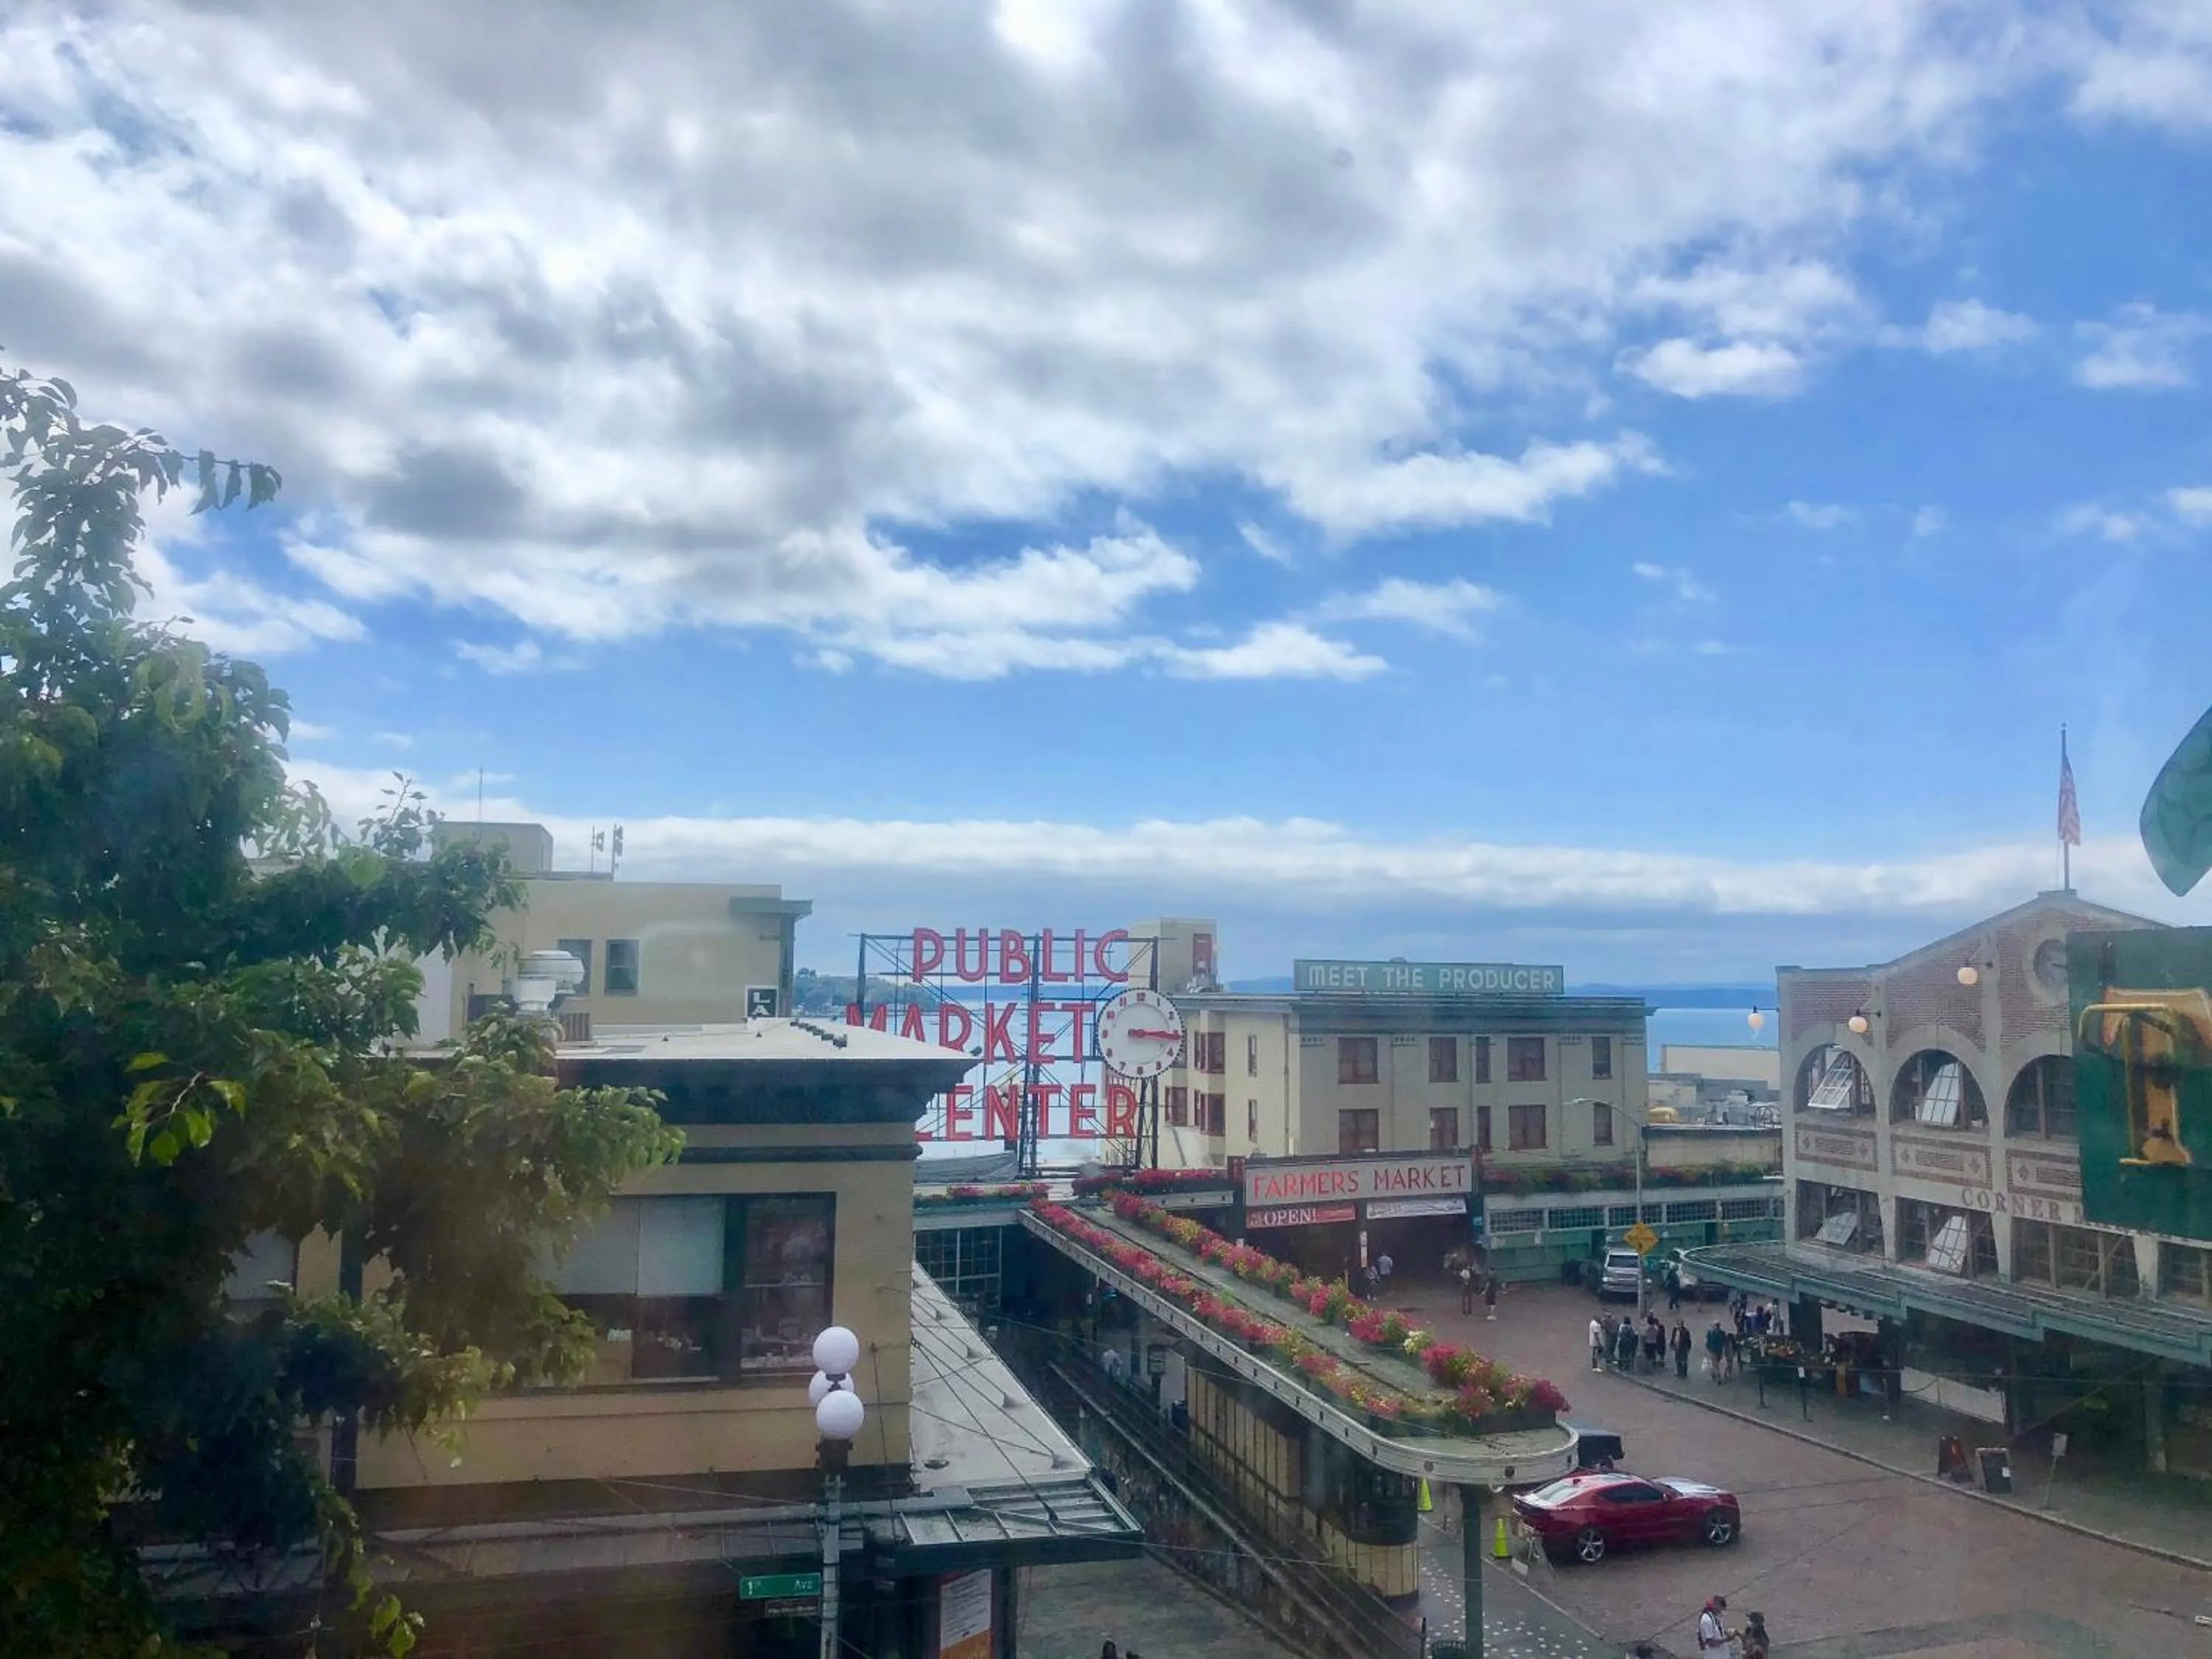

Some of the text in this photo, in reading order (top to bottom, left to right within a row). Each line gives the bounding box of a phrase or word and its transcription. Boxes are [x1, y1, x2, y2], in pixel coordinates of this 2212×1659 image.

[912, 927, 1128, 983] PUBLIC
[1309, 965, 1556, 990] MEET THE PRODUCER
[914, 1084, 1138, 1141] ENTER
[1253, 1164, 1465, 1199] FARMERS MARKET
[1263, 1207, 1316, 1226] OPEN!
[1961, 1187, 2062, 1221] CORNER
